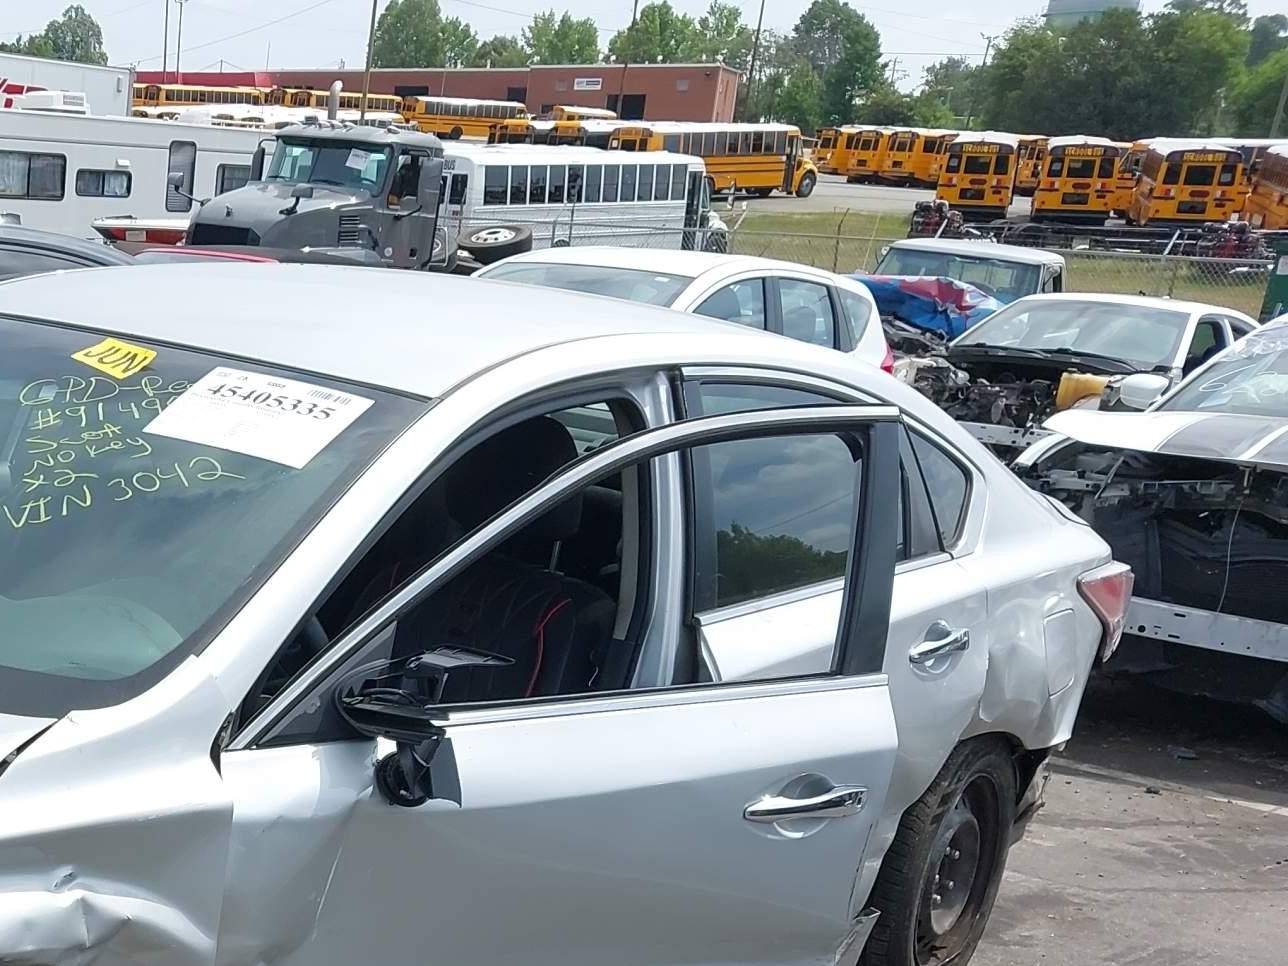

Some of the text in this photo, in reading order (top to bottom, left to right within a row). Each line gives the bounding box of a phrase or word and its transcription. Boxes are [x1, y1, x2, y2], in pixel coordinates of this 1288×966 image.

[83, 345, 149, 374] JUN
[208, 383, 337, 420] 45405335
[3, 456, 246, 528] VIN 3042
